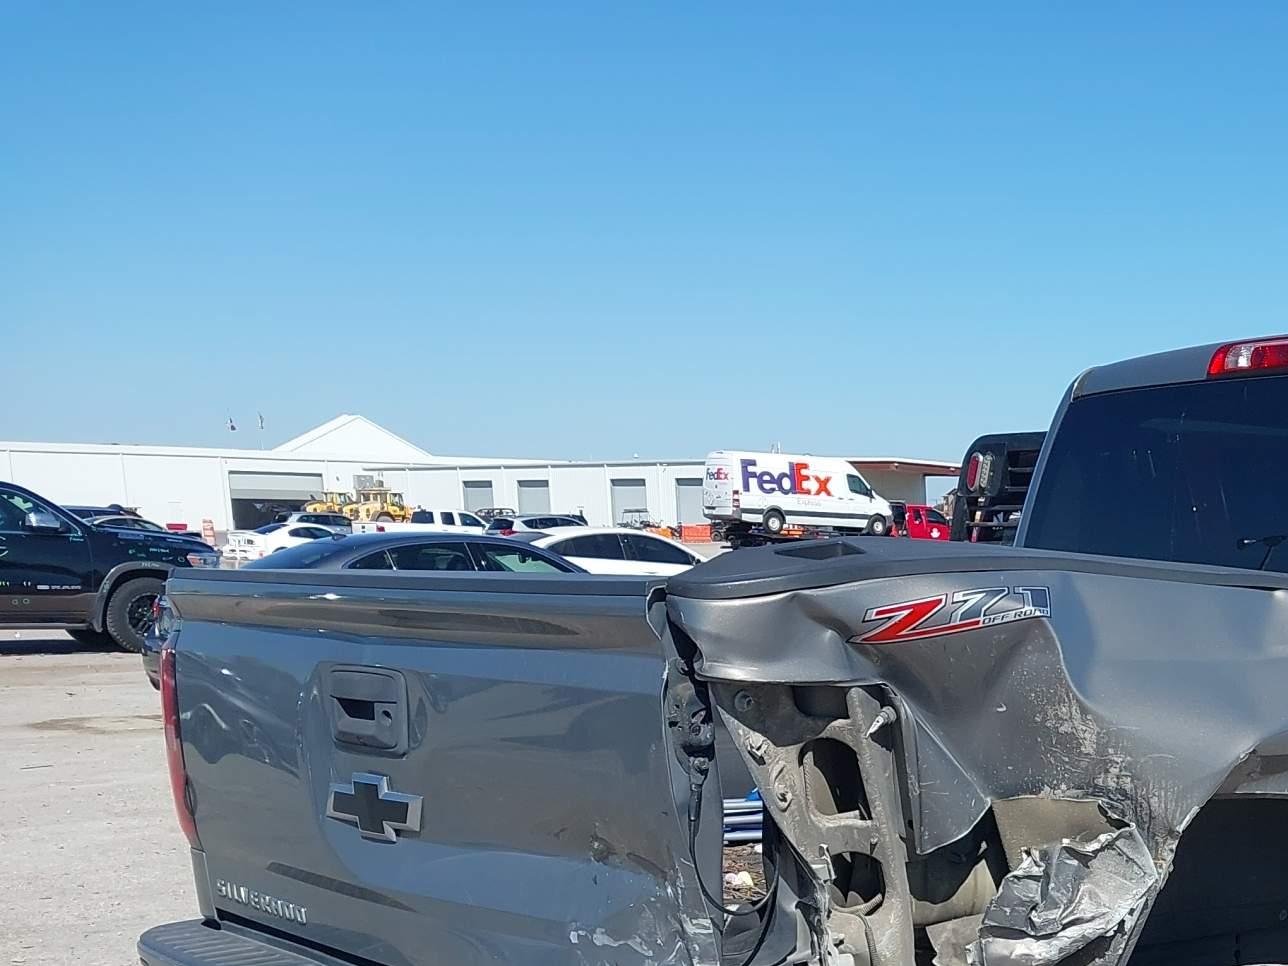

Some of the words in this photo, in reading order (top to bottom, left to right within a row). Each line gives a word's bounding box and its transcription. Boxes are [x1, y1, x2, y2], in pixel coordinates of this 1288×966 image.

[706, 467, 729, 480] FedEx
[740, 459, 833, 497] FedEx
[846, 586, 1051, 645] Z71
[982, 614, 1010, 625] OFF
[1014, 607, 1049, 618] ROAD
[217, 880, 307, 925] SILVERADO
